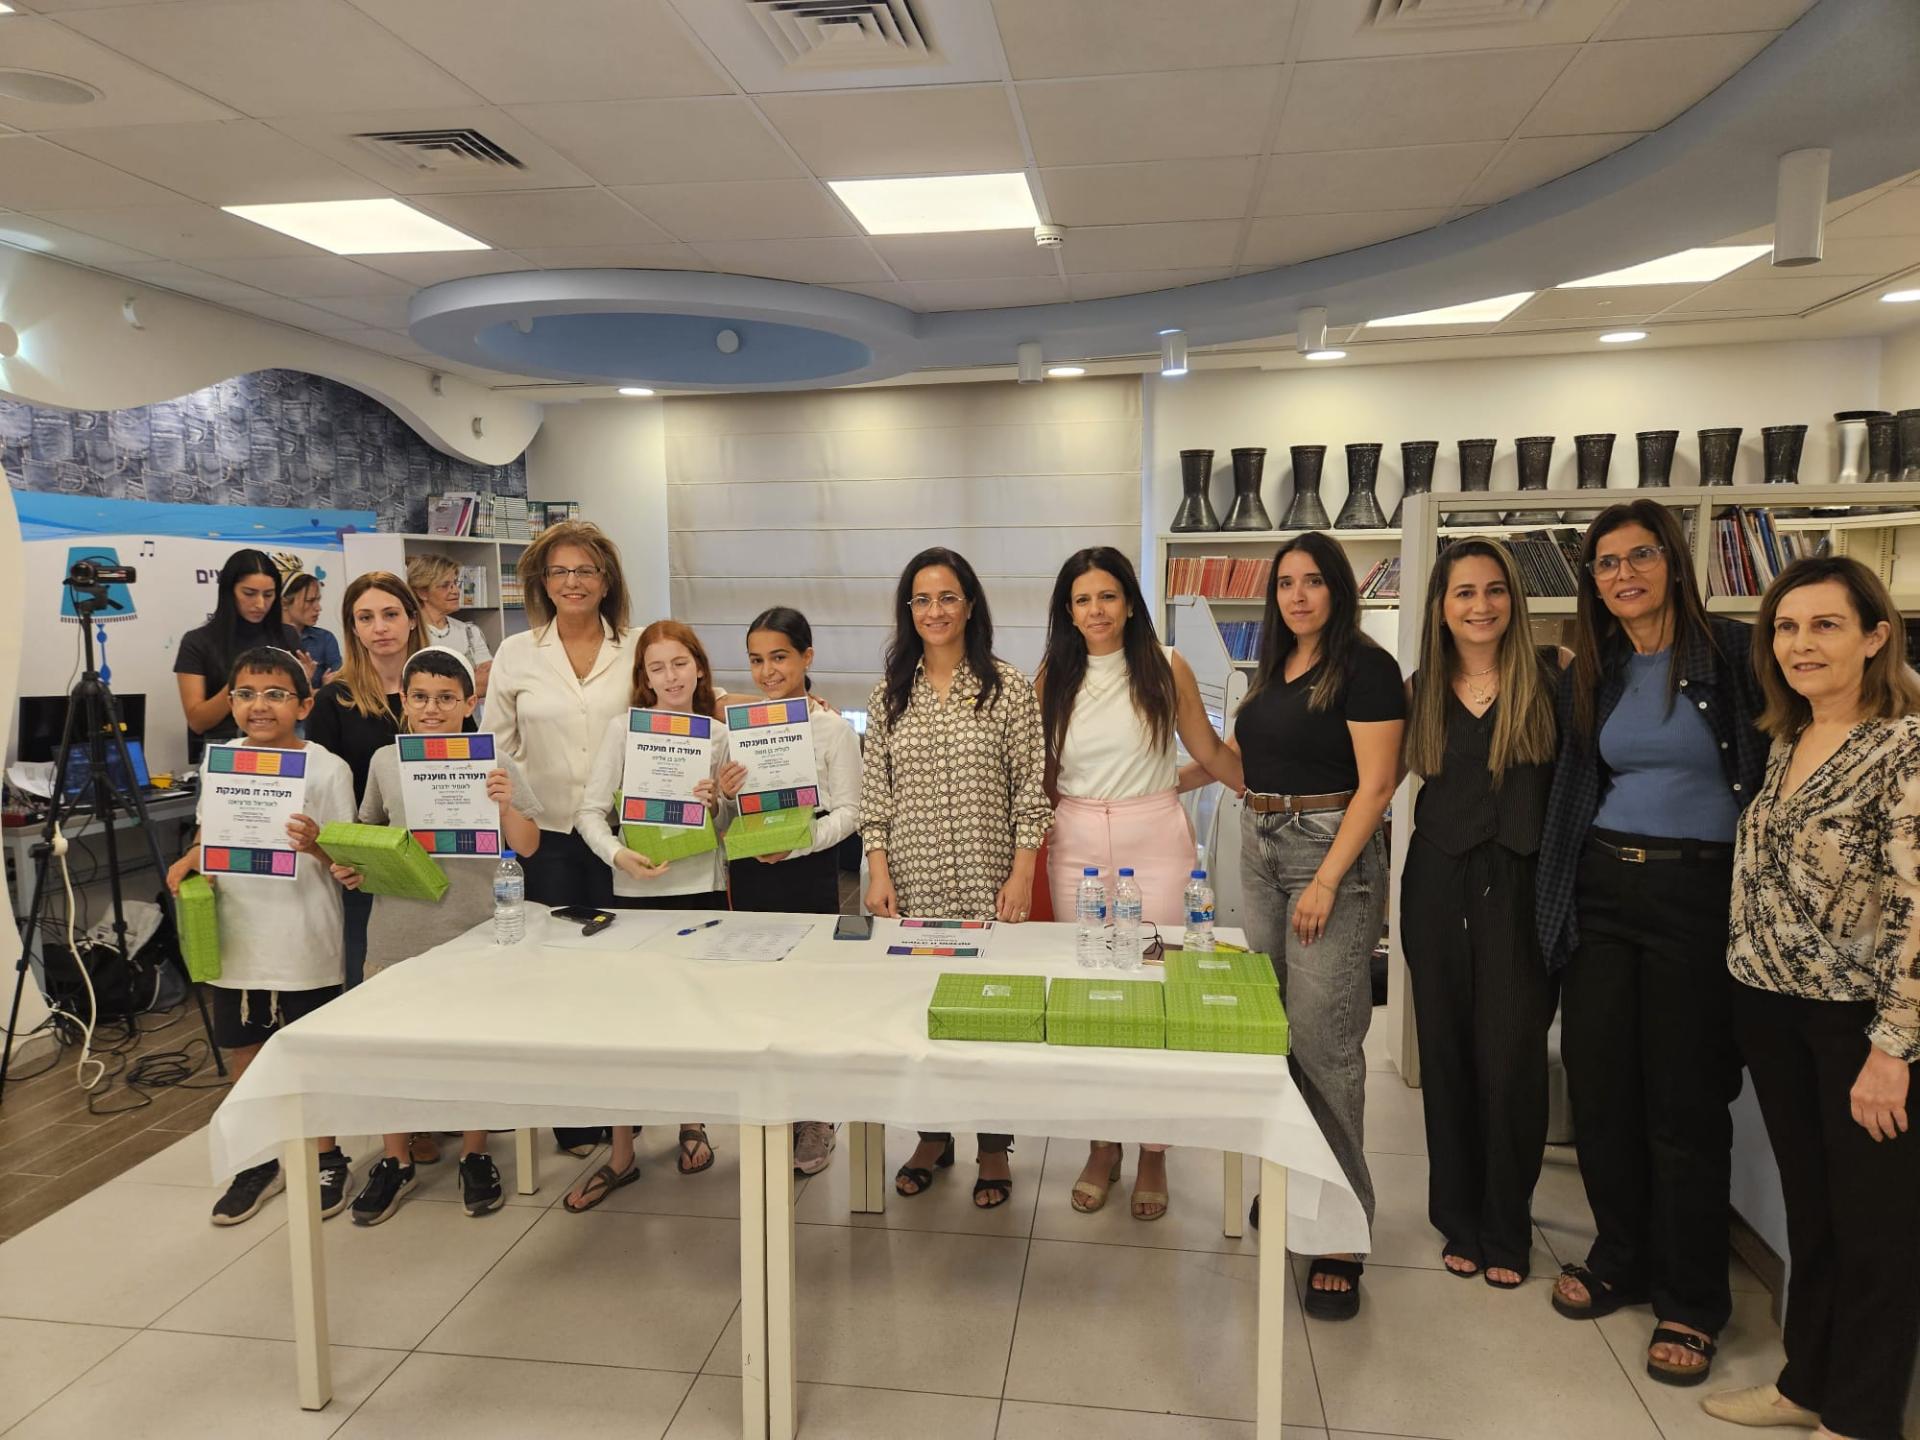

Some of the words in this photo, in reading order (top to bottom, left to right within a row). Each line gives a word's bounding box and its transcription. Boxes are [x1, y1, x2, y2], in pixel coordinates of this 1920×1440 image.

[739, 738, 768, 748] מוענקת
[778, 734, 803, 743] תעודה
[637, 743, 667, 752] מוענקת
[677, 747, 702, 756] תעודה
[413, 773, 447, 781] מוענקת
[216, 786, 250, 795] מוענקת
[253, 788, 261, 796] זו
[263, 789, 291, 797] תעודה
